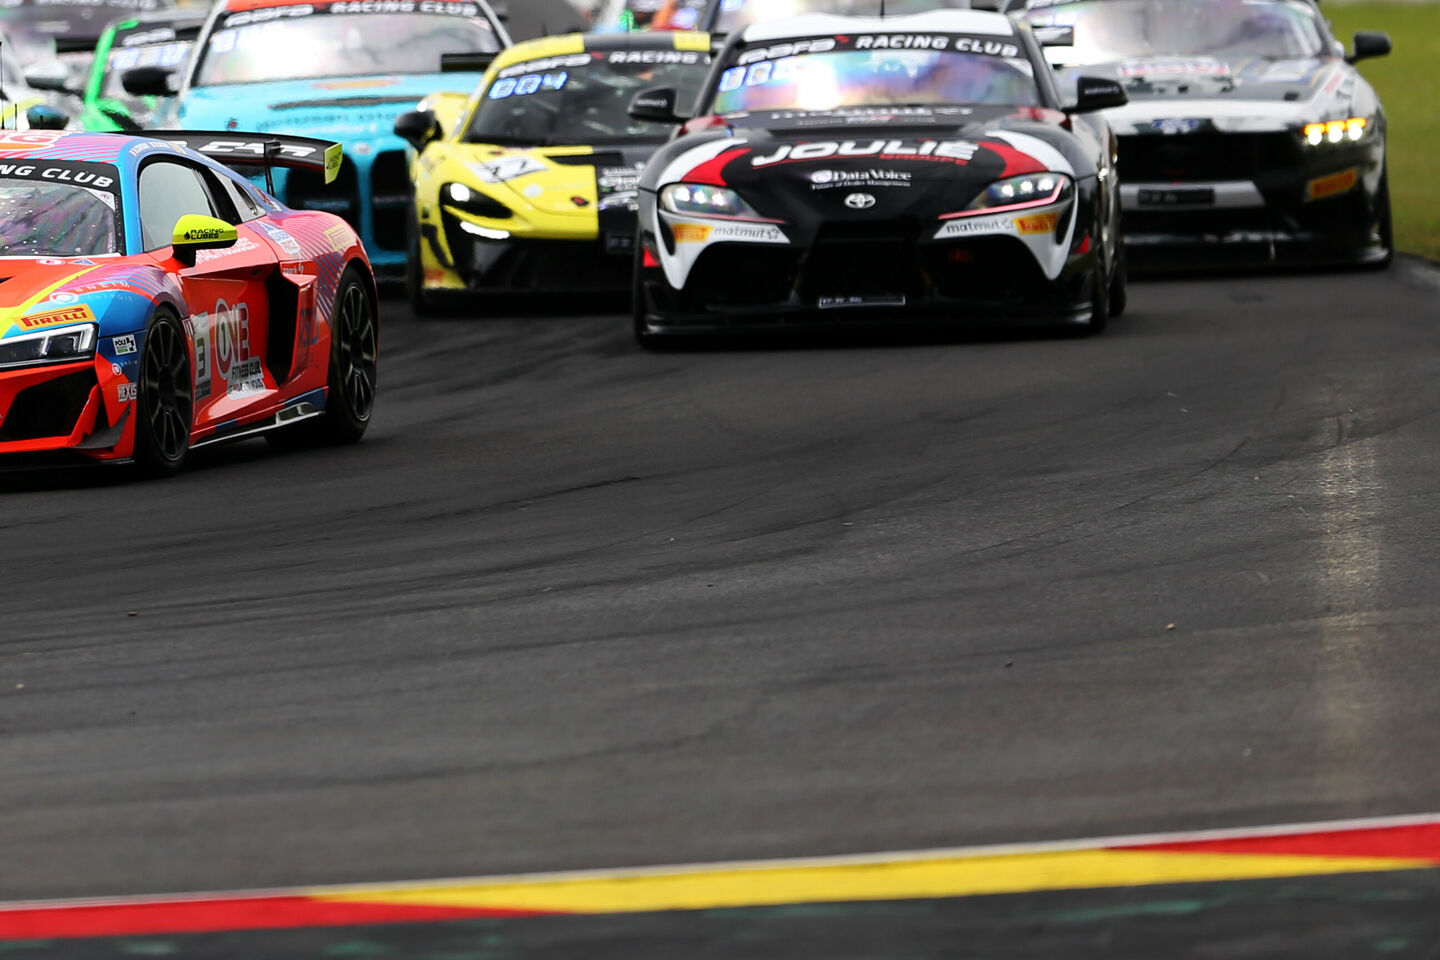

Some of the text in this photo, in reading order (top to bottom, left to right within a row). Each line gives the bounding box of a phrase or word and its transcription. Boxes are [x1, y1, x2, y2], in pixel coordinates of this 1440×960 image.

[330, 0, 414, 14] RACING
[420, 1, 477, 16] CLUB
[855, 34, 949, 49] RACING
[955, 38, 1018, 58] CLUB
[609, 51, 698, 64] RACING
[751, 140, 980, 167] JOULIE
[41, 167, 114, 188] CLUB
[714, 227, 766, 239] matmut
[946, 220, 1000, 234] matmut
[21, 307, 88, 328] PIRELLI
